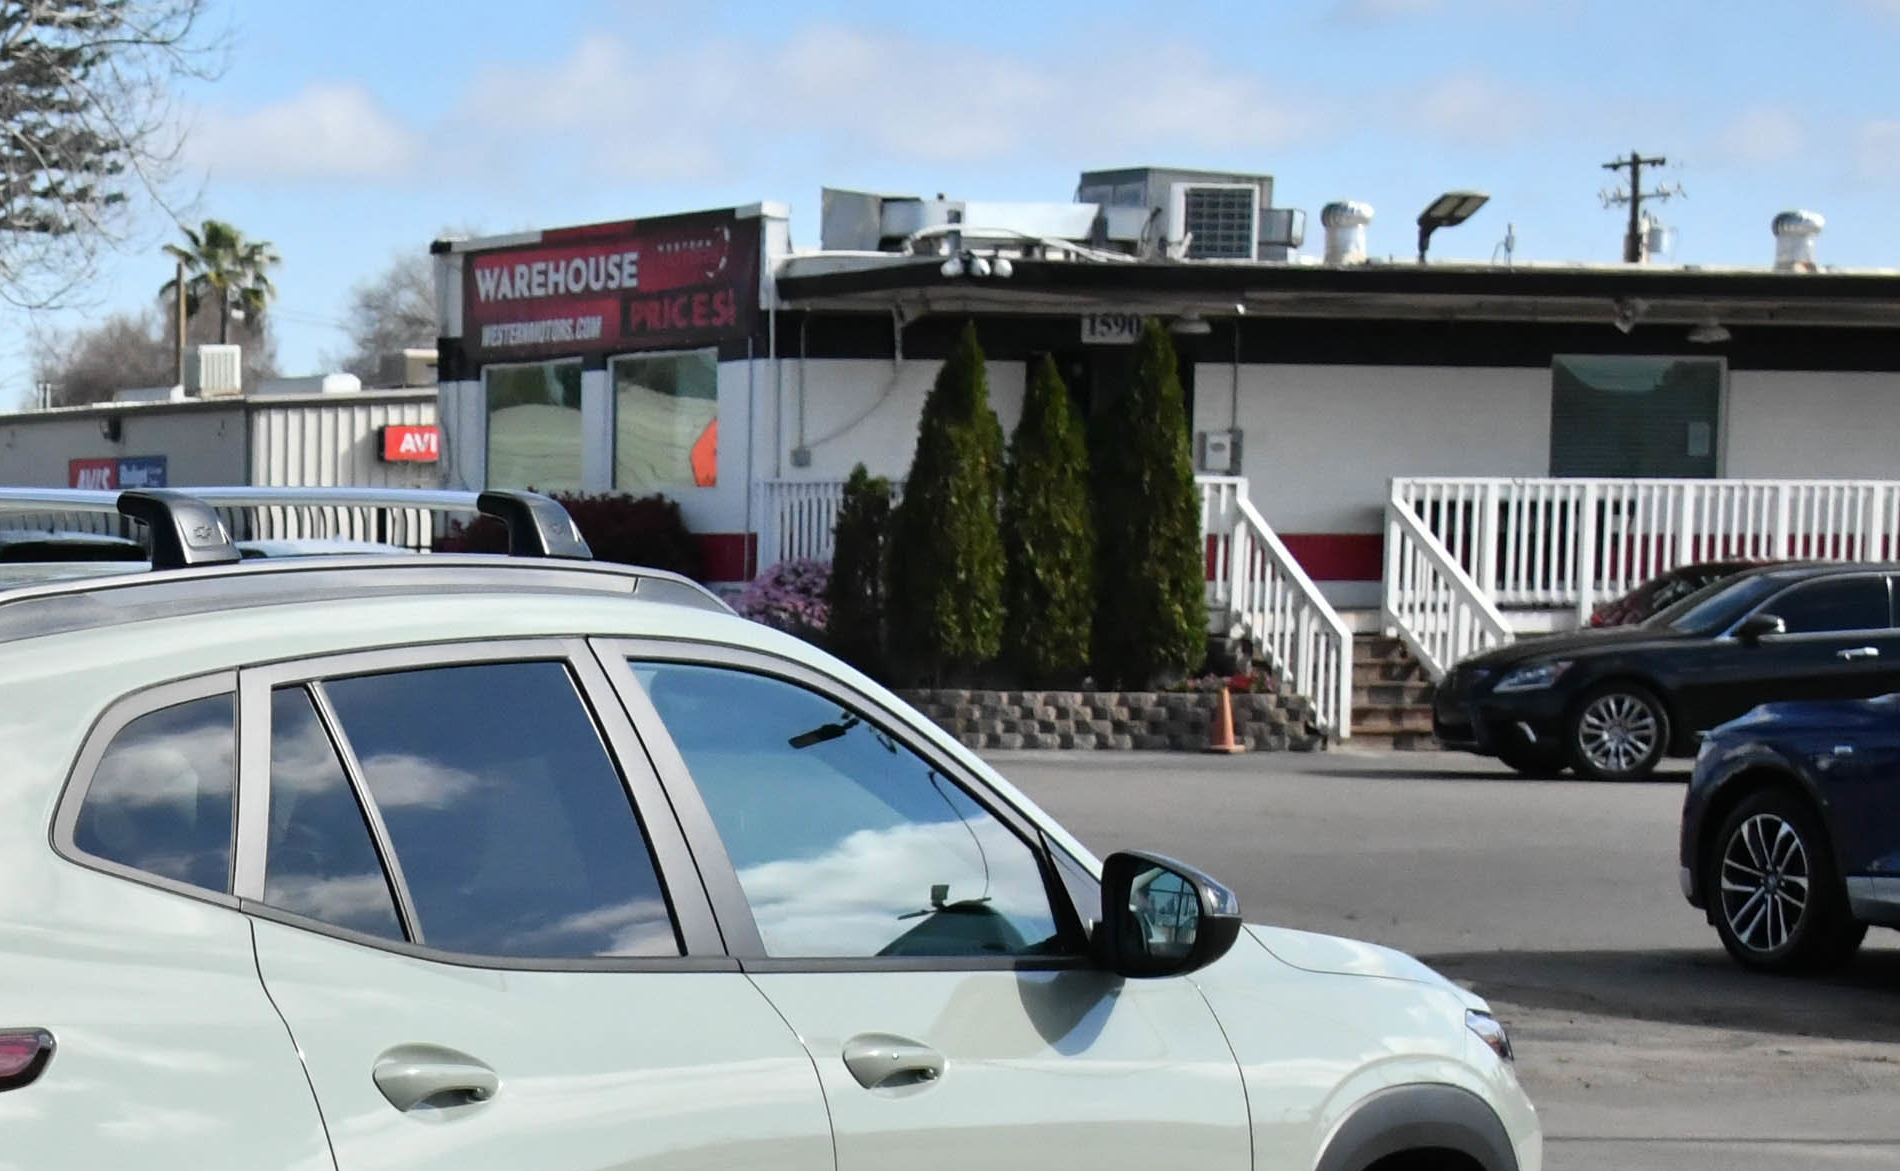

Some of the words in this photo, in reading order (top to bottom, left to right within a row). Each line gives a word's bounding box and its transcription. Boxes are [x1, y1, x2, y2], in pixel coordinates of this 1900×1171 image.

[474, 251, 640, 303] WAREHOUSE
[630, 287, 736, 331] PRICES!
[1089, 312, 1142, 336] 1590
[399, 432, 438, 453] AVI
